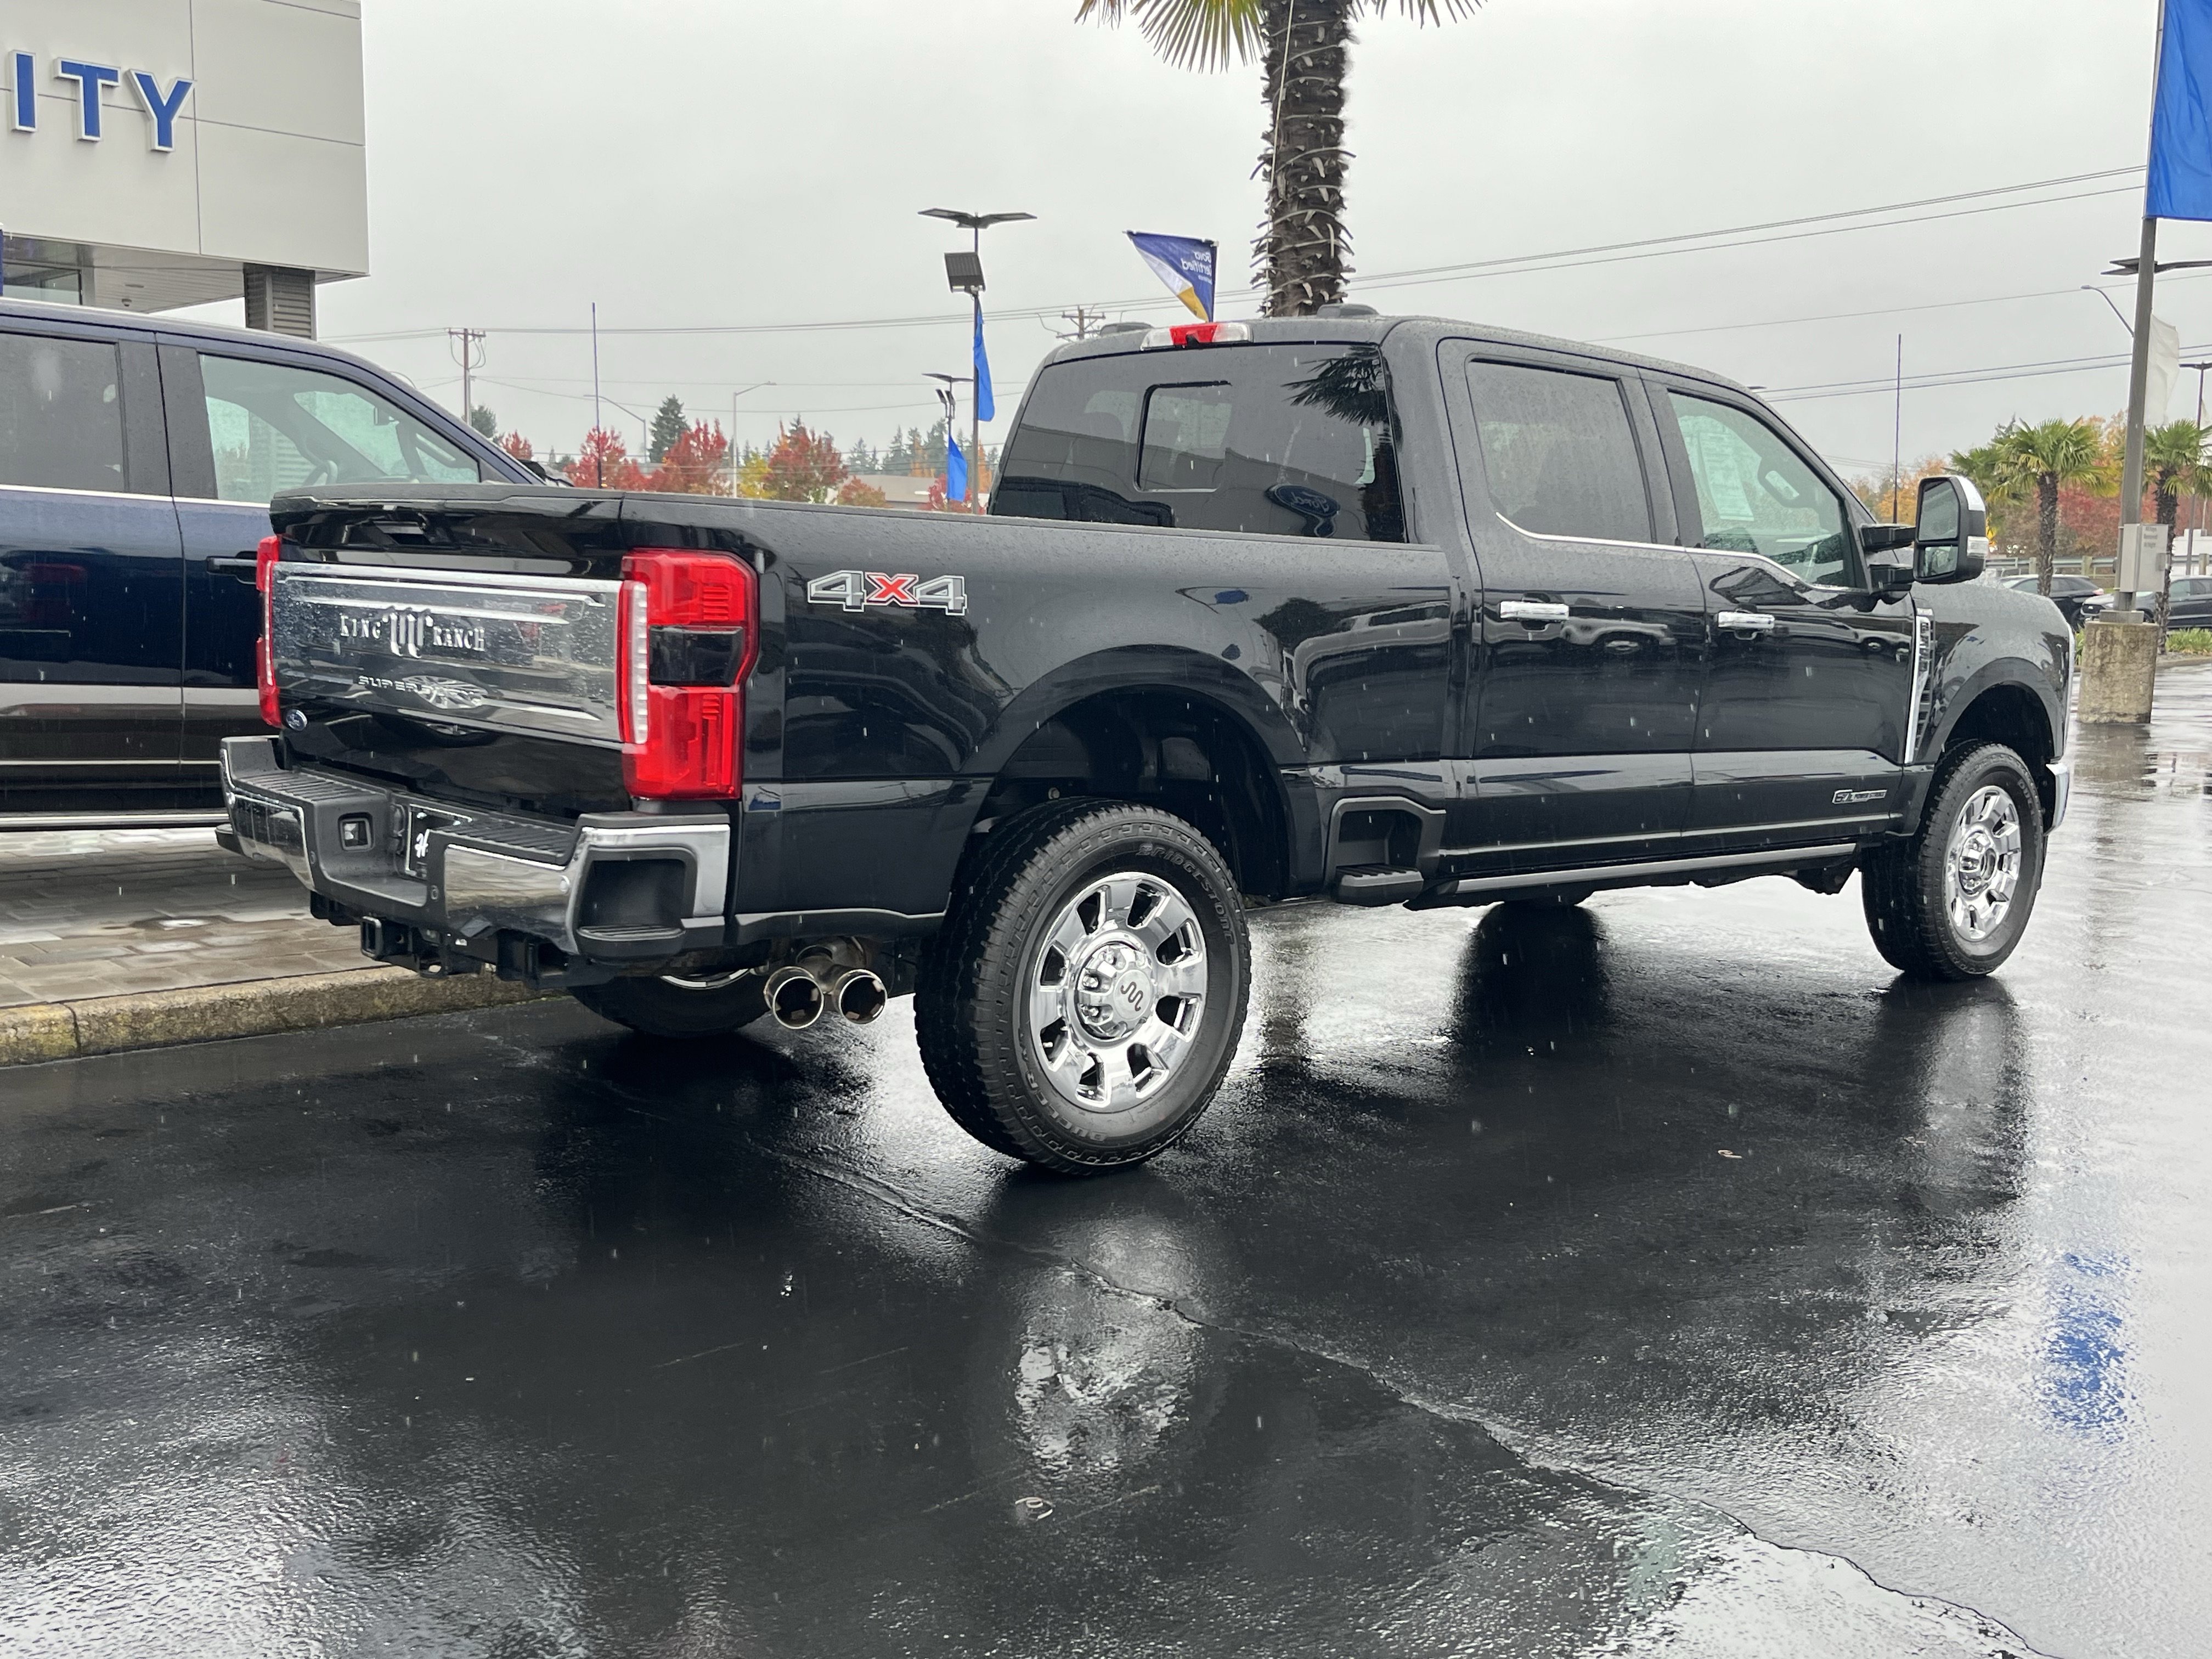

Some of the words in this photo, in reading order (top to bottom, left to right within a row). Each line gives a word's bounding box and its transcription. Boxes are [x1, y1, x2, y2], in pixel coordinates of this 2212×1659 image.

[10, 50, 196, 152] ITY
[340, 614, 382, 640] KING
[432, 625, 486, 652] RANCH
[358, 675, 419, 693] SUPER
